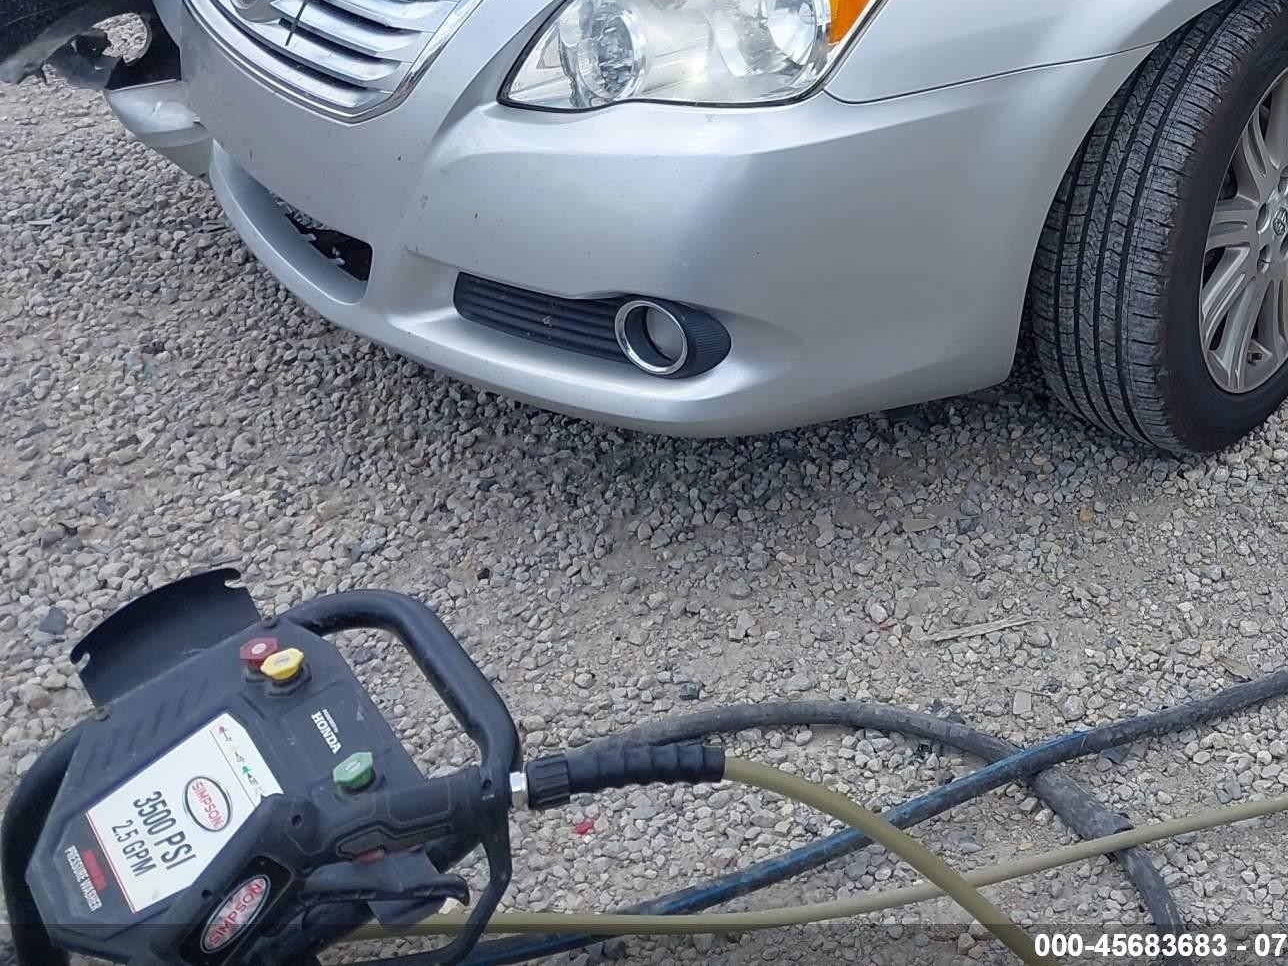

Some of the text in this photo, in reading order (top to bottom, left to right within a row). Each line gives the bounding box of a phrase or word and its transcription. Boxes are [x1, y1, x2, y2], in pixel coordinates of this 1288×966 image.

[311, 710, 343, 755] HONDA
[133, 791, 197, 870] 3500 PSI
[192, 780, 225, 828] SIMPSON
[64, 845, 89, 883] PRESSURE
[79, 875, 103, 912] WASHER
[111, 819, 157, 878] 2.5 GPM
[209, 882, 262, 945] SIMPSON
